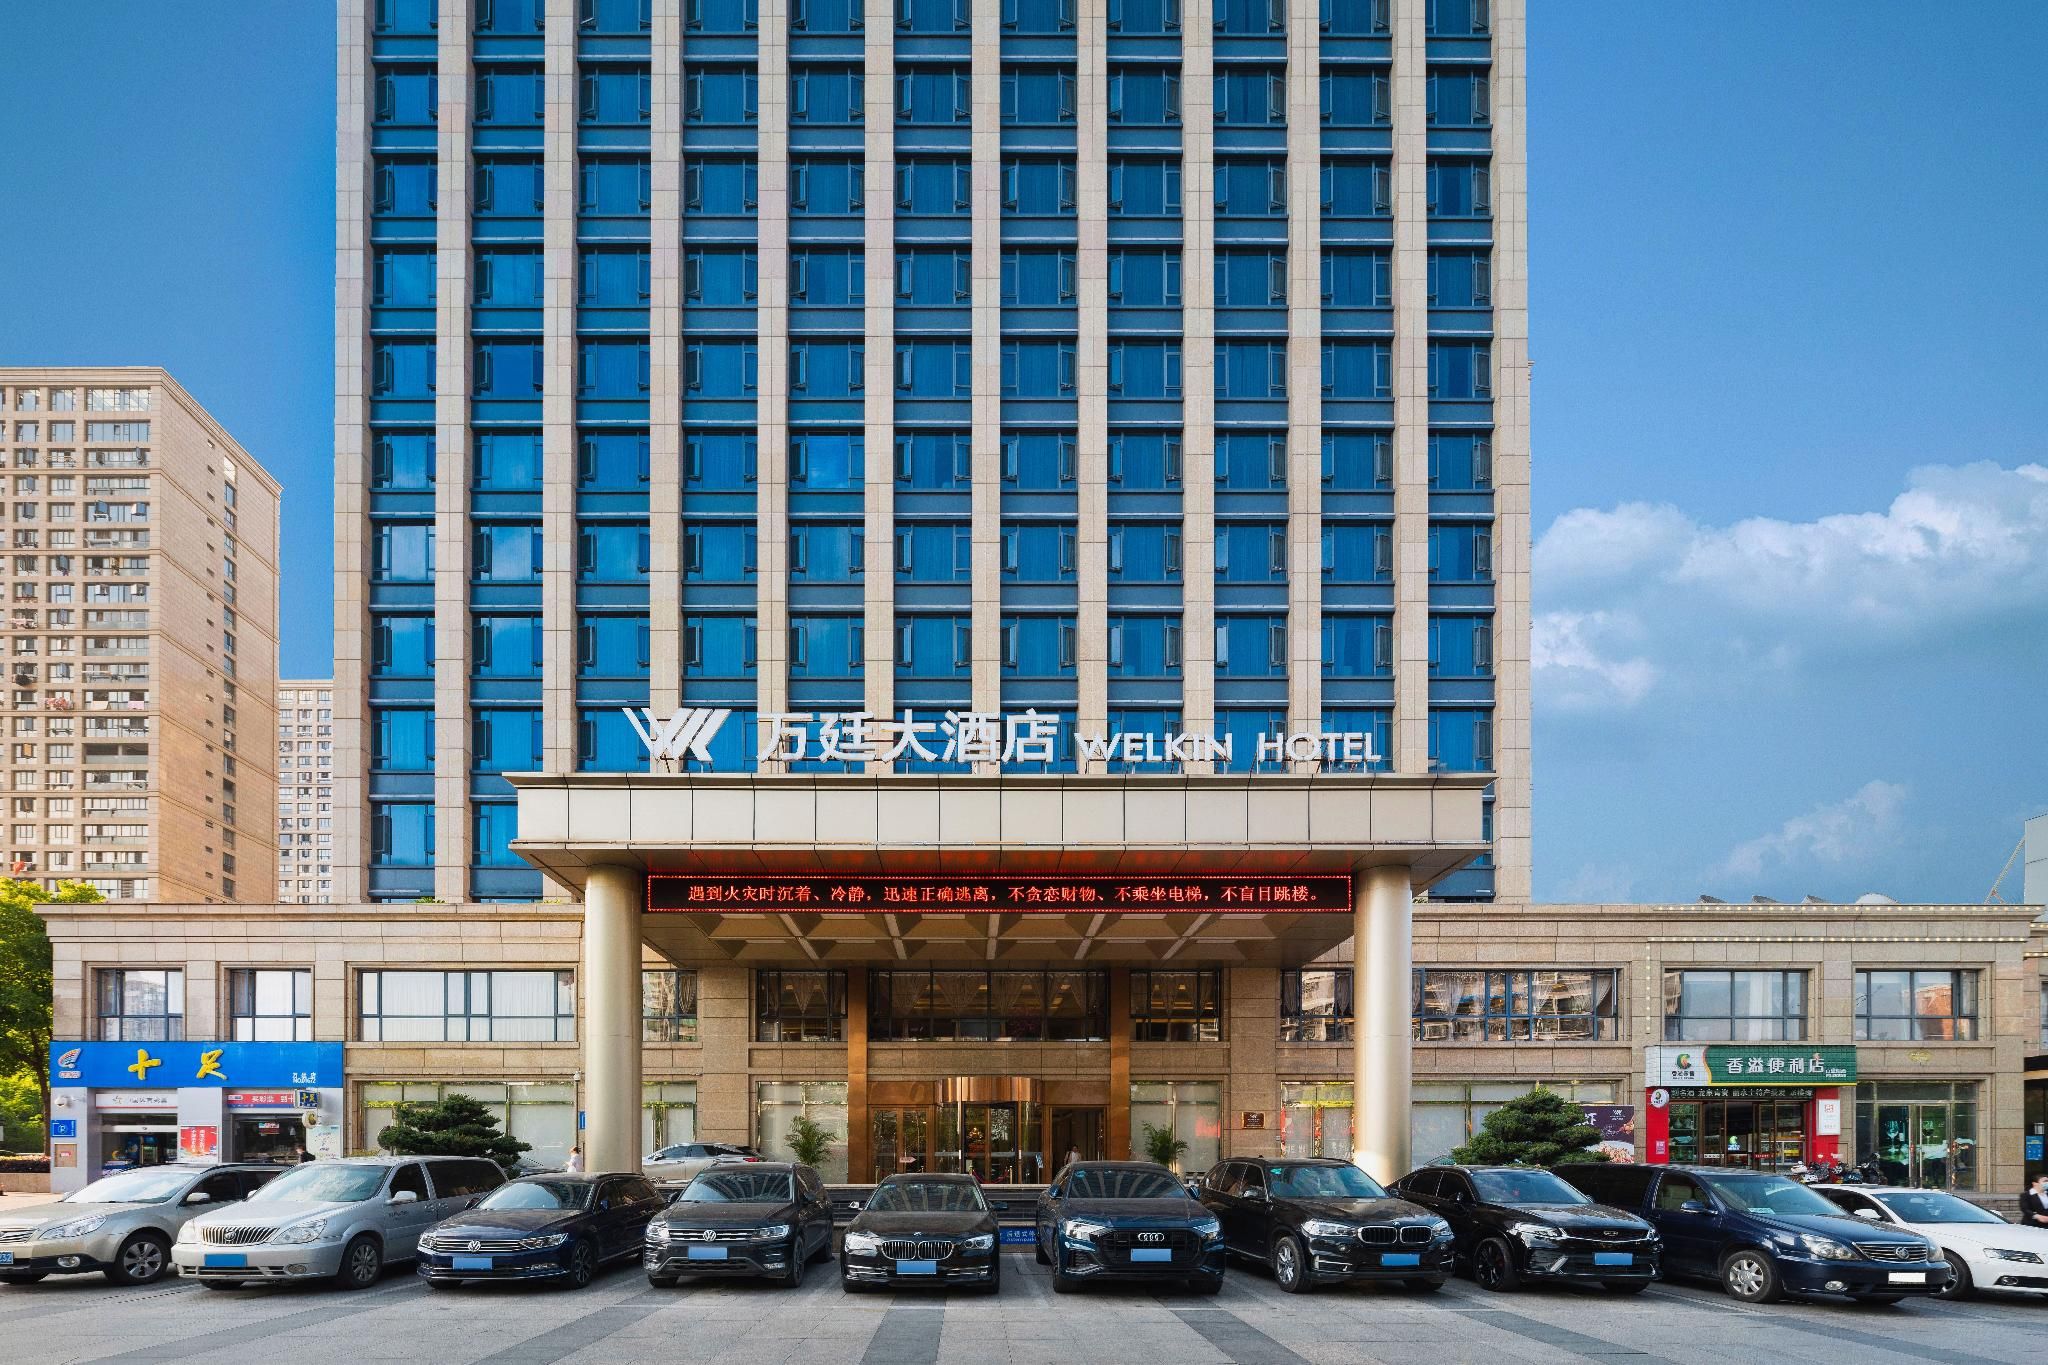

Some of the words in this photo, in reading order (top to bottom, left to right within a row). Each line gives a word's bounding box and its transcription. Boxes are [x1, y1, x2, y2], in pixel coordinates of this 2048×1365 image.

[755, 709, 1061, 764] 万廷大酒店
[1074, 731, 1234, 763] WELKIN
[1257, 731, 1382, 763] HOTEL
[1726, 1057, 1825, 1074] 香溢便利店
